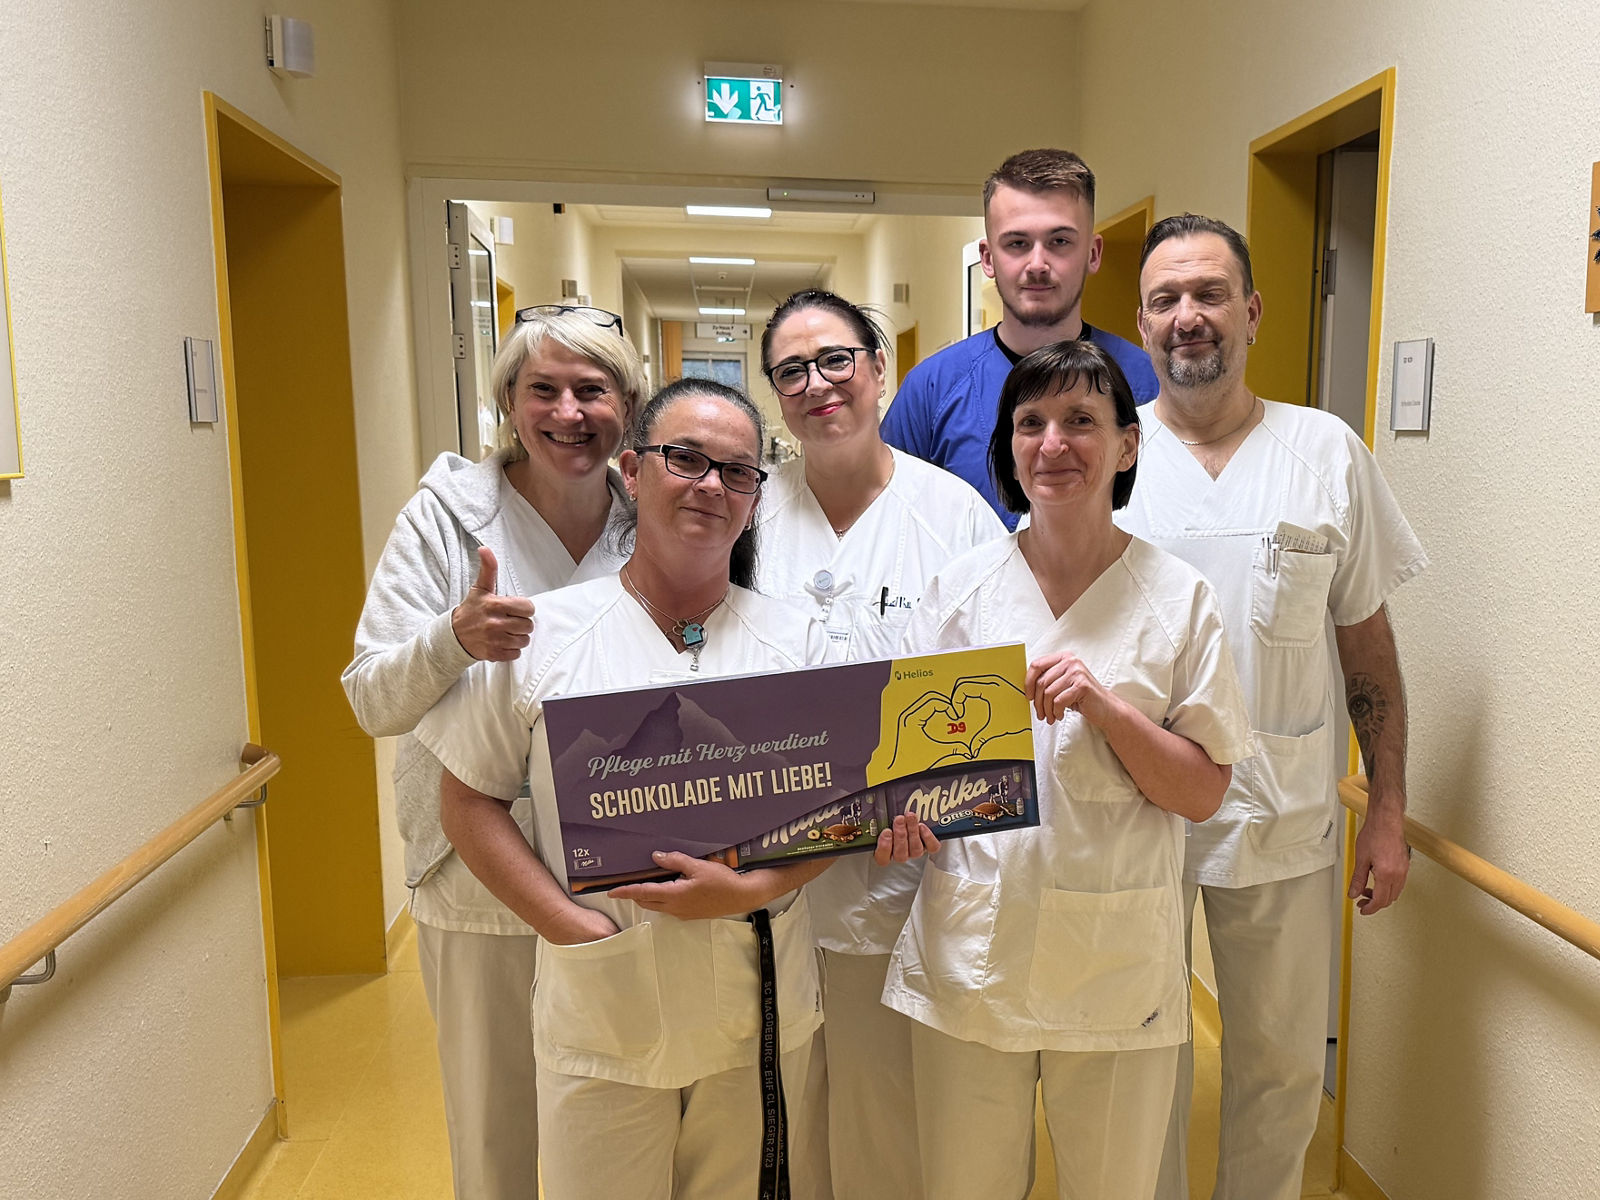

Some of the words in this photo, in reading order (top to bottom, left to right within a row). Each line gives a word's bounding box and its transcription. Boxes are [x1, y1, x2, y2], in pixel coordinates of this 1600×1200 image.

[903, 669, 934, 680] Helios
[946, 721, 967, 735] D9
[587, 754, 654, 781] Pflege
[657, 747, 693, 767] mit
[695, 742, 748, 763] Herz
[749, 729, 830, 755] verdient
[588, 776, 723, 820] SCHOKOLADE
[727, 770, 765, 800] MIT
[770, 761, 833, 795] LIEBE!
[904, 773, 992, 823] Milka
[571, 847, 590, 858] 12x
[764, 980, 772, 995] SC
[764, 997, 774, 1062] MAGDEBURG
[764, 1070, 774, 1091] EHF
[767, 1108, 776, 1145] SIEGER
[764, 1146, 775, 1169] 2023
